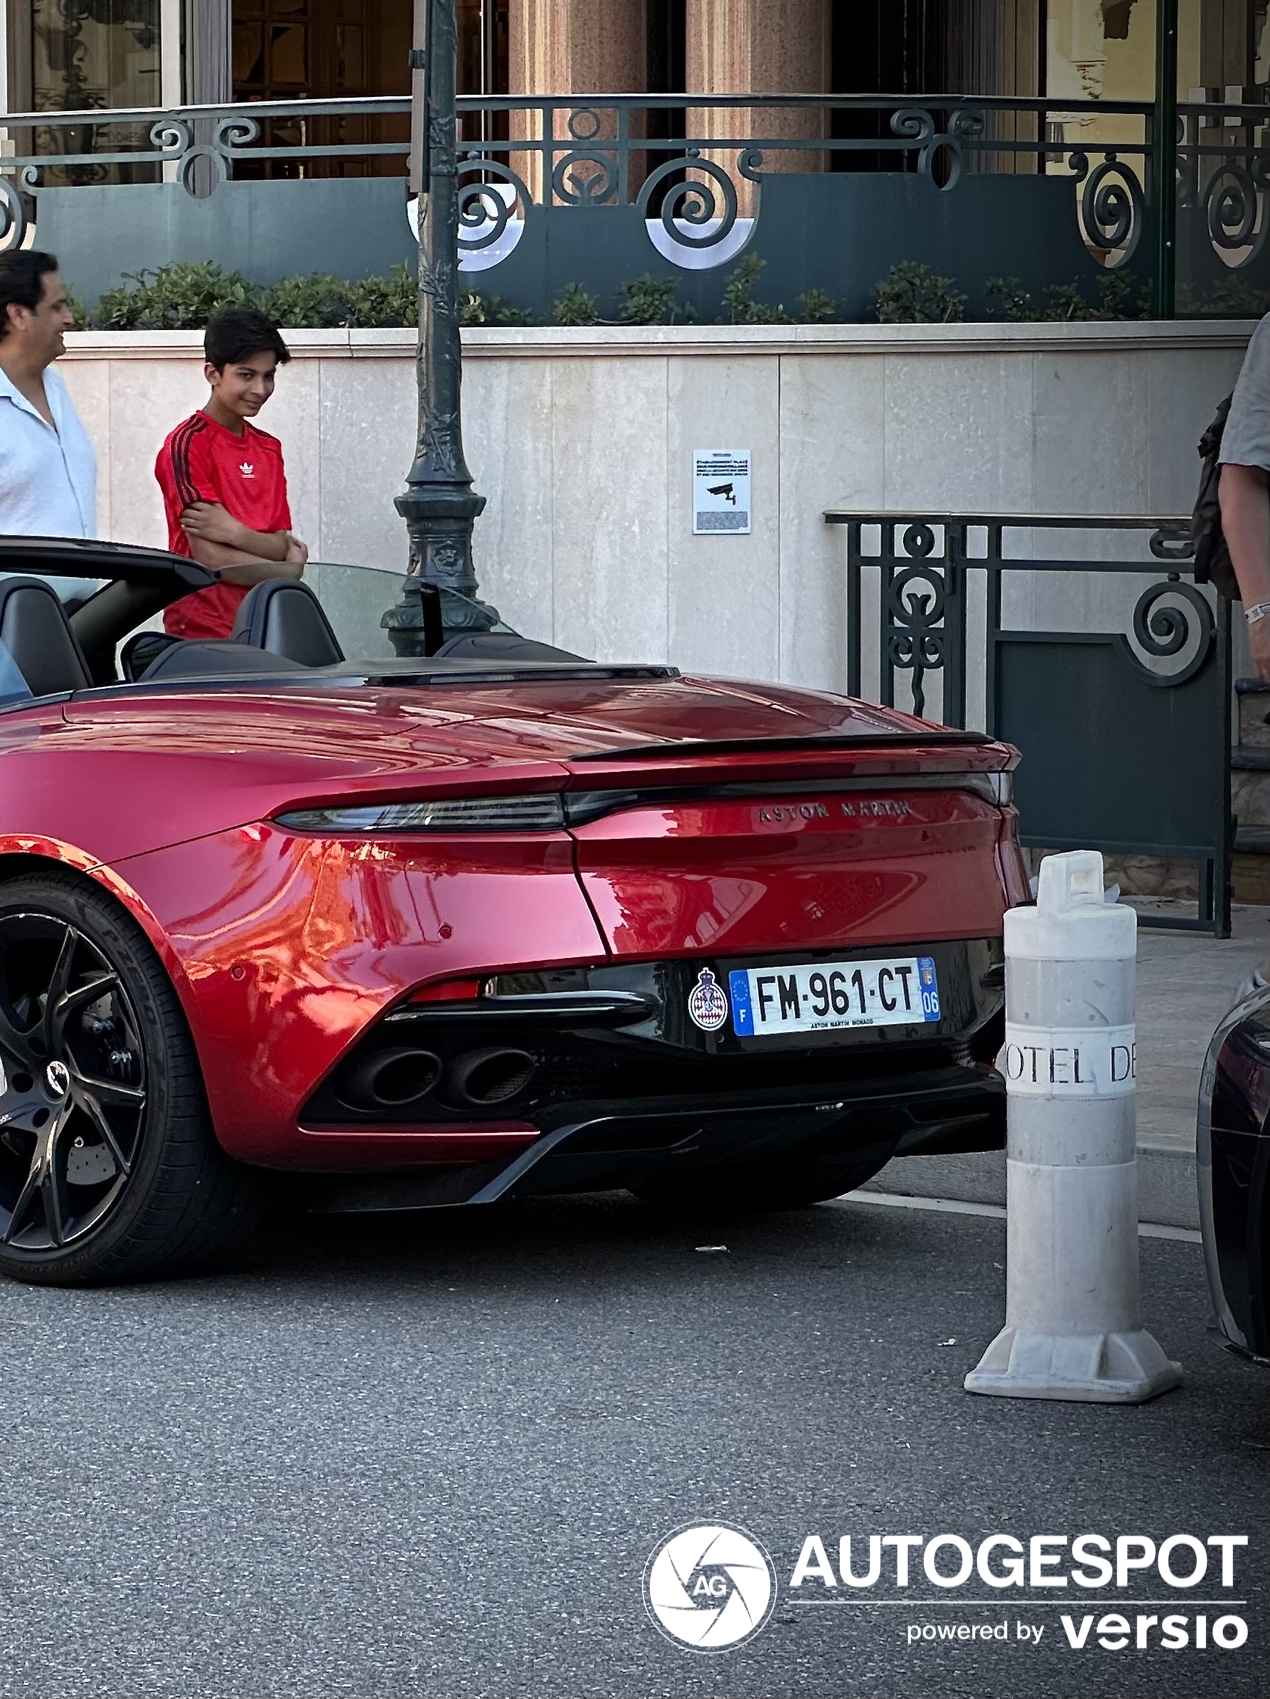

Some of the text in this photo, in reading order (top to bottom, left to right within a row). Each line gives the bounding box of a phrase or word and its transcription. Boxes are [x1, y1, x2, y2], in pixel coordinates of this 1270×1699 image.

[759, 800, 913, 822] ASTON MARTIN
[756, 965, 912, 1022] FM-961-CT
[923, 991, 939, 1014] 06
[739, 1009, 746, 1023] F
